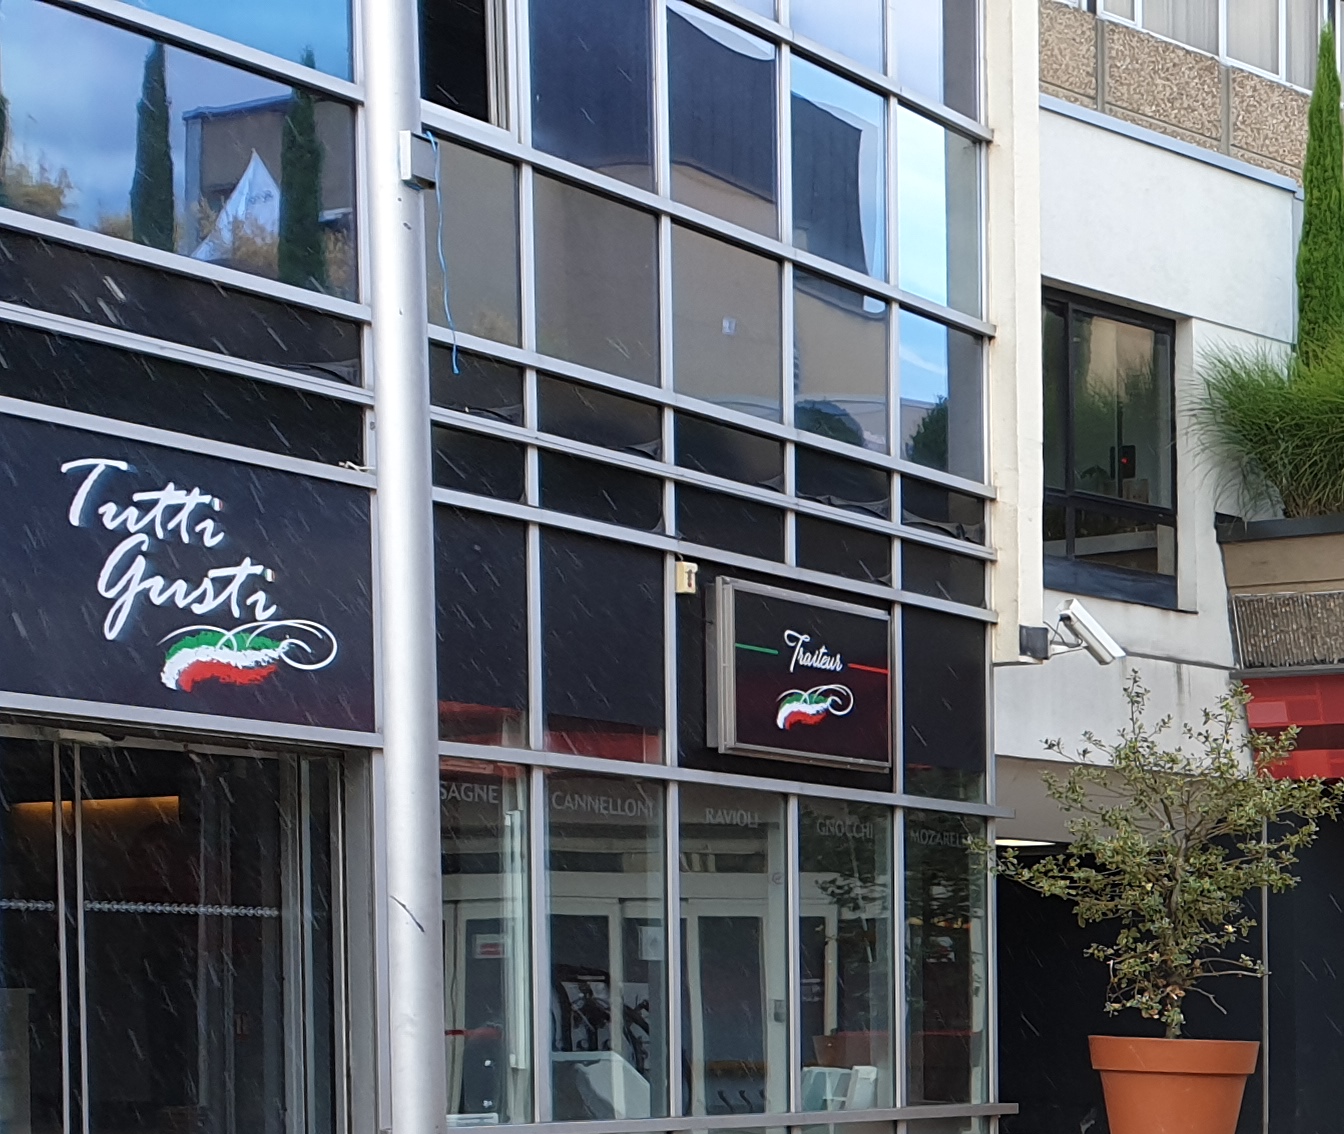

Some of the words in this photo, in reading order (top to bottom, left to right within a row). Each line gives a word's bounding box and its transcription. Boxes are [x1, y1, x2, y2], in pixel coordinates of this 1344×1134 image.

[60, 457, 227, 548] Tutti
[97, 533, 278, 641] Gusti
[783, 628, 844, 673] Traiteur
[551, 790, 655, 818] CANNELLONI
[704, 807, 759, 829] RAVIOLI
[816, 818, 875, 840] GNOCCHI
